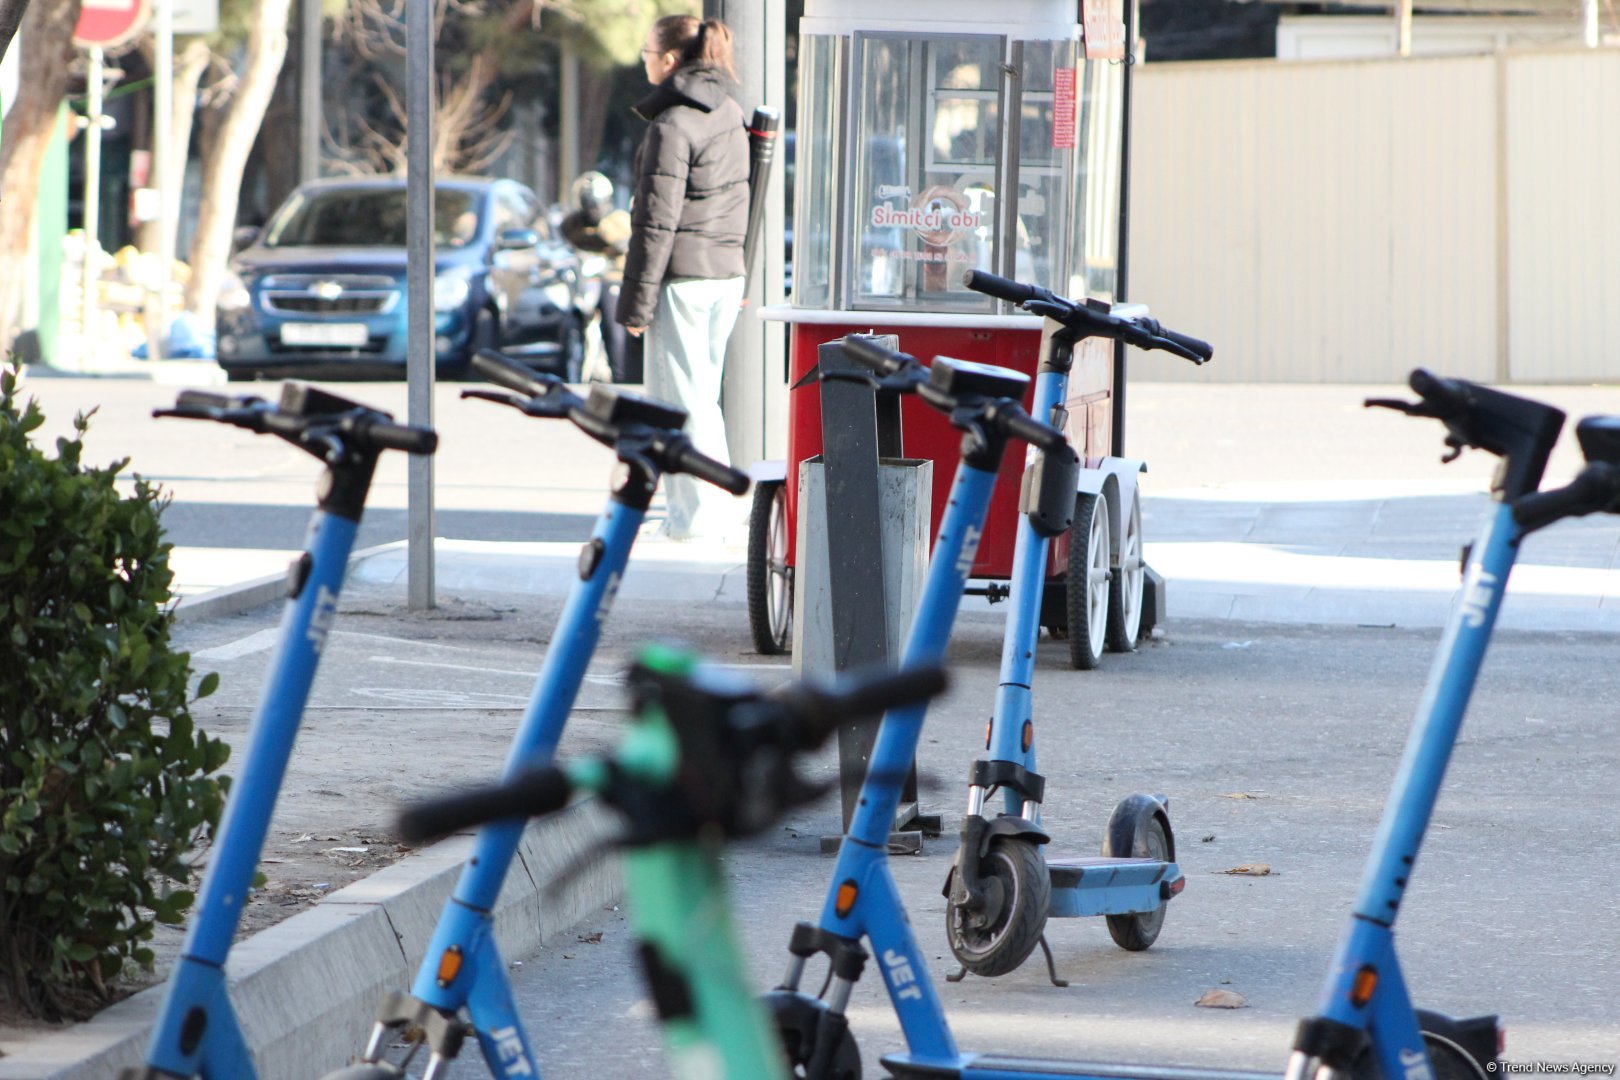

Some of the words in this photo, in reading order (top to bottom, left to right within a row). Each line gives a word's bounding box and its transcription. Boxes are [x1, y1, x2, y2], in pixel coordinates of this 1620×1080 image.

[951, 213, 980, 227] abi
[1460, 563, 1497, 627] JET
[883, 949, 922, 1000] JET
[490, 1025, 532, 1075] JET
